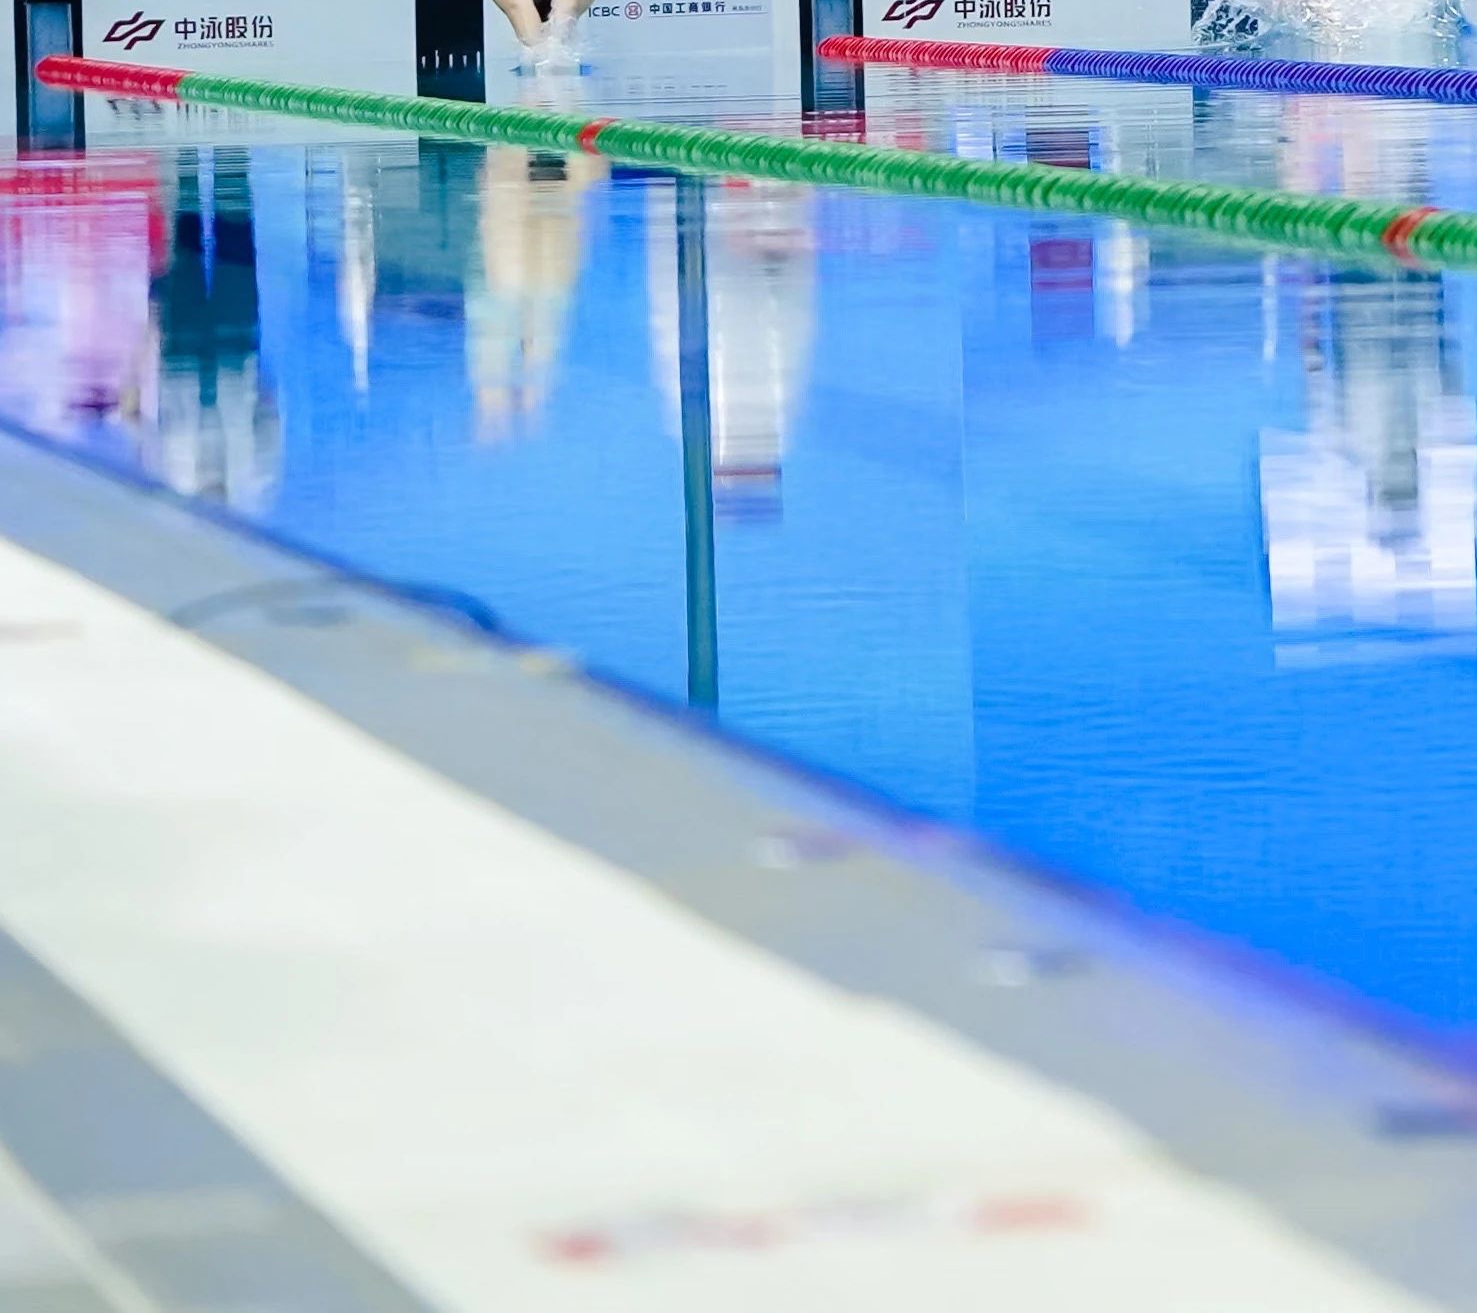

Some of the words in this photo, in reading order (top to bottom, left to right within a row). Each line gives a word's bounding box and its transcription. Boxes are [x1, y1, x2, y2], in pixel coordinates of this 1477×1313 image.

[588, 4, 621, 18] ICBC
[649, 0, 727, 16] 中国工商银行
[174, 15, 274, 42] 中泳股份
